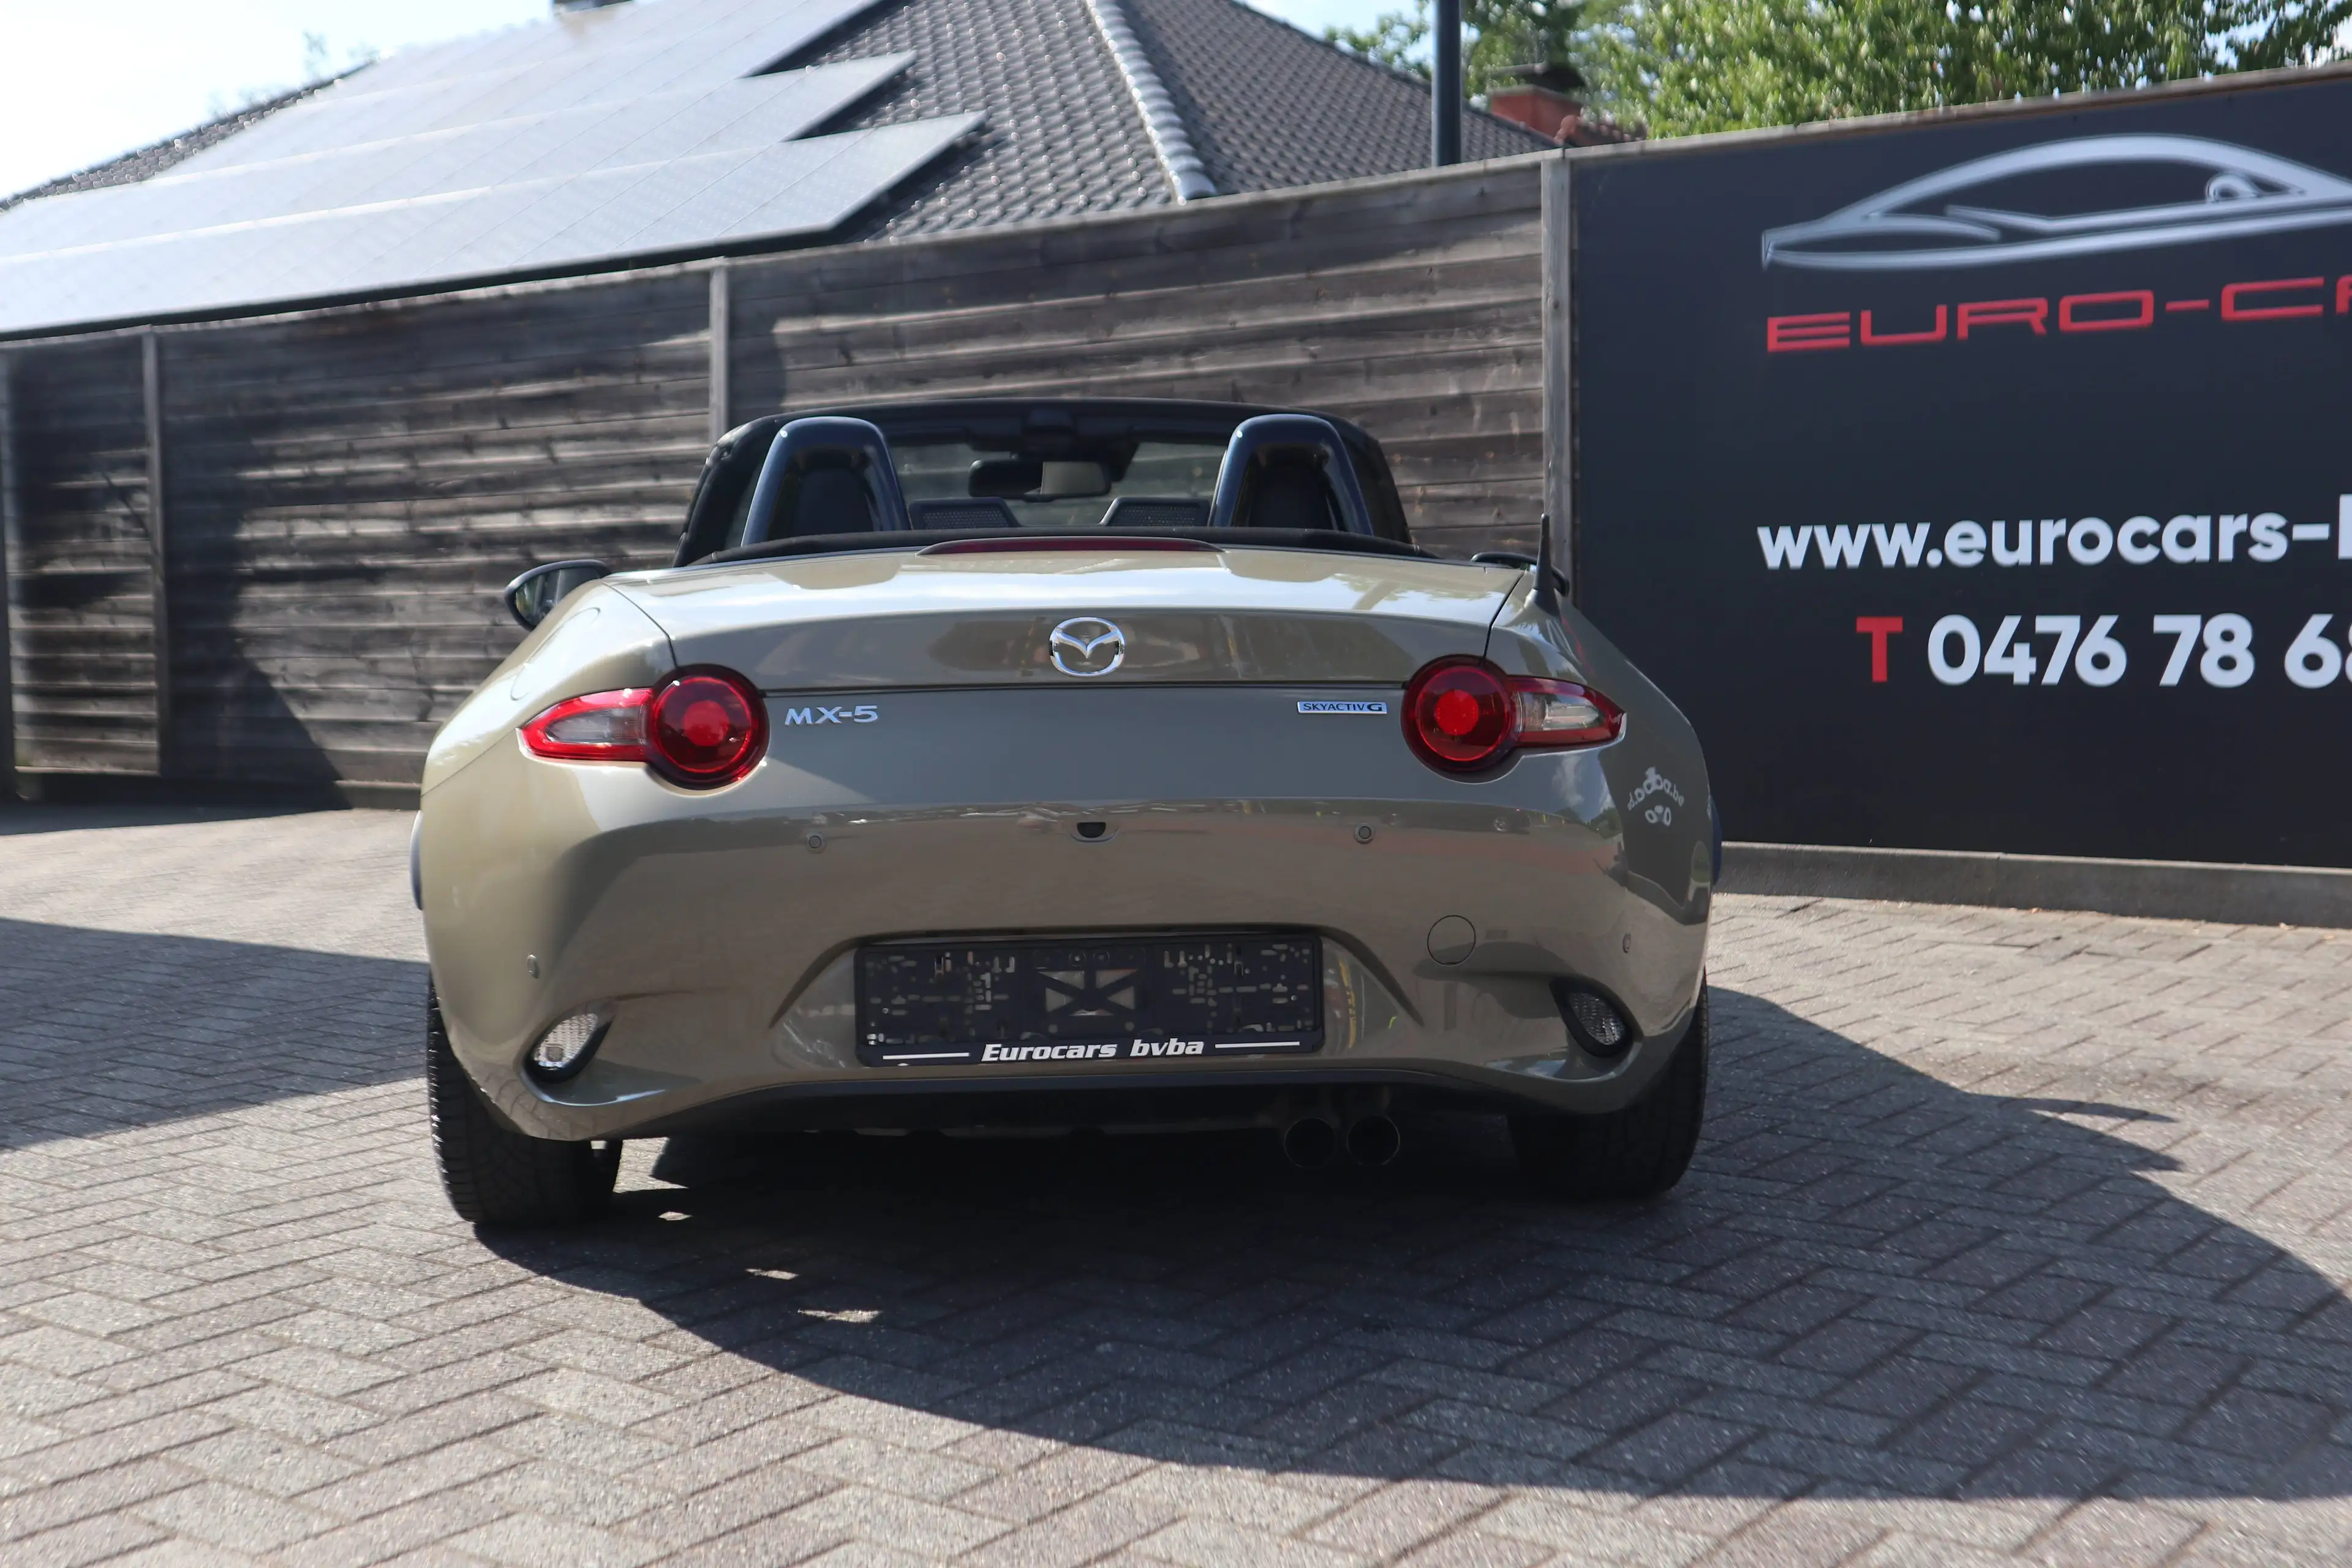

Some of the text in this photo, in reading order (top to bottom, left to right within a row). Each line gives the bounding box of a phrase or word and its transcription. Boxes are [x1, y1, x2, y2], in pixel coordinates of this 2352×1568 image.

[1766, 276, 2352, 352] EURO-C
[1757, 494, 2352, 569] www.eurocars-
[1855, 612, 2352, 689] T 0476 78 6
[784, 705, 878, 725] MX-5
[981, 1038, 1205, 1062] Eurocars bvba
